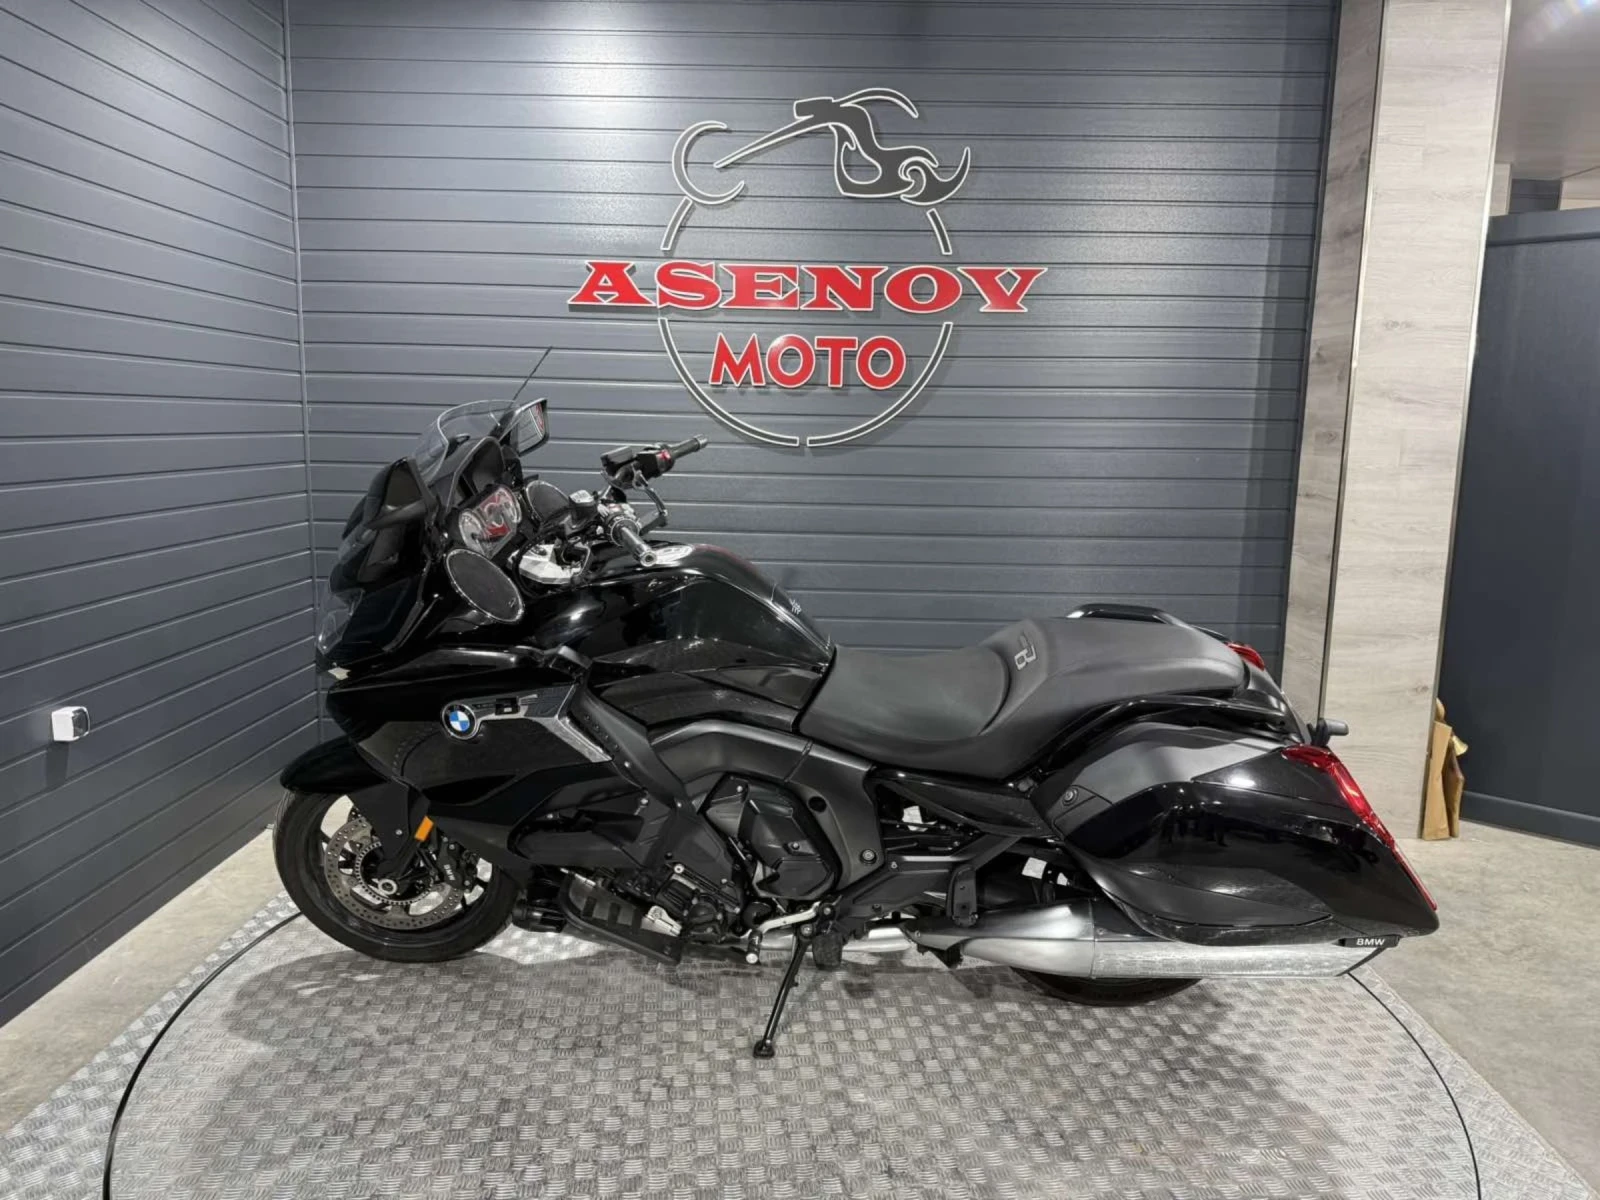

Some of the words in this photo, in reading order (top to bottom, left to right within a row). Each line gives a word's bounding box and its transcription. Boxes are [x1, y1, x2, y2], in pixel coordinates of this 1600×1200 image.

[567, 260, 1049, 314] ASENOV
[708, 332, 907, 390] MOTO
[1356, 938, 1386, 946] BMW
